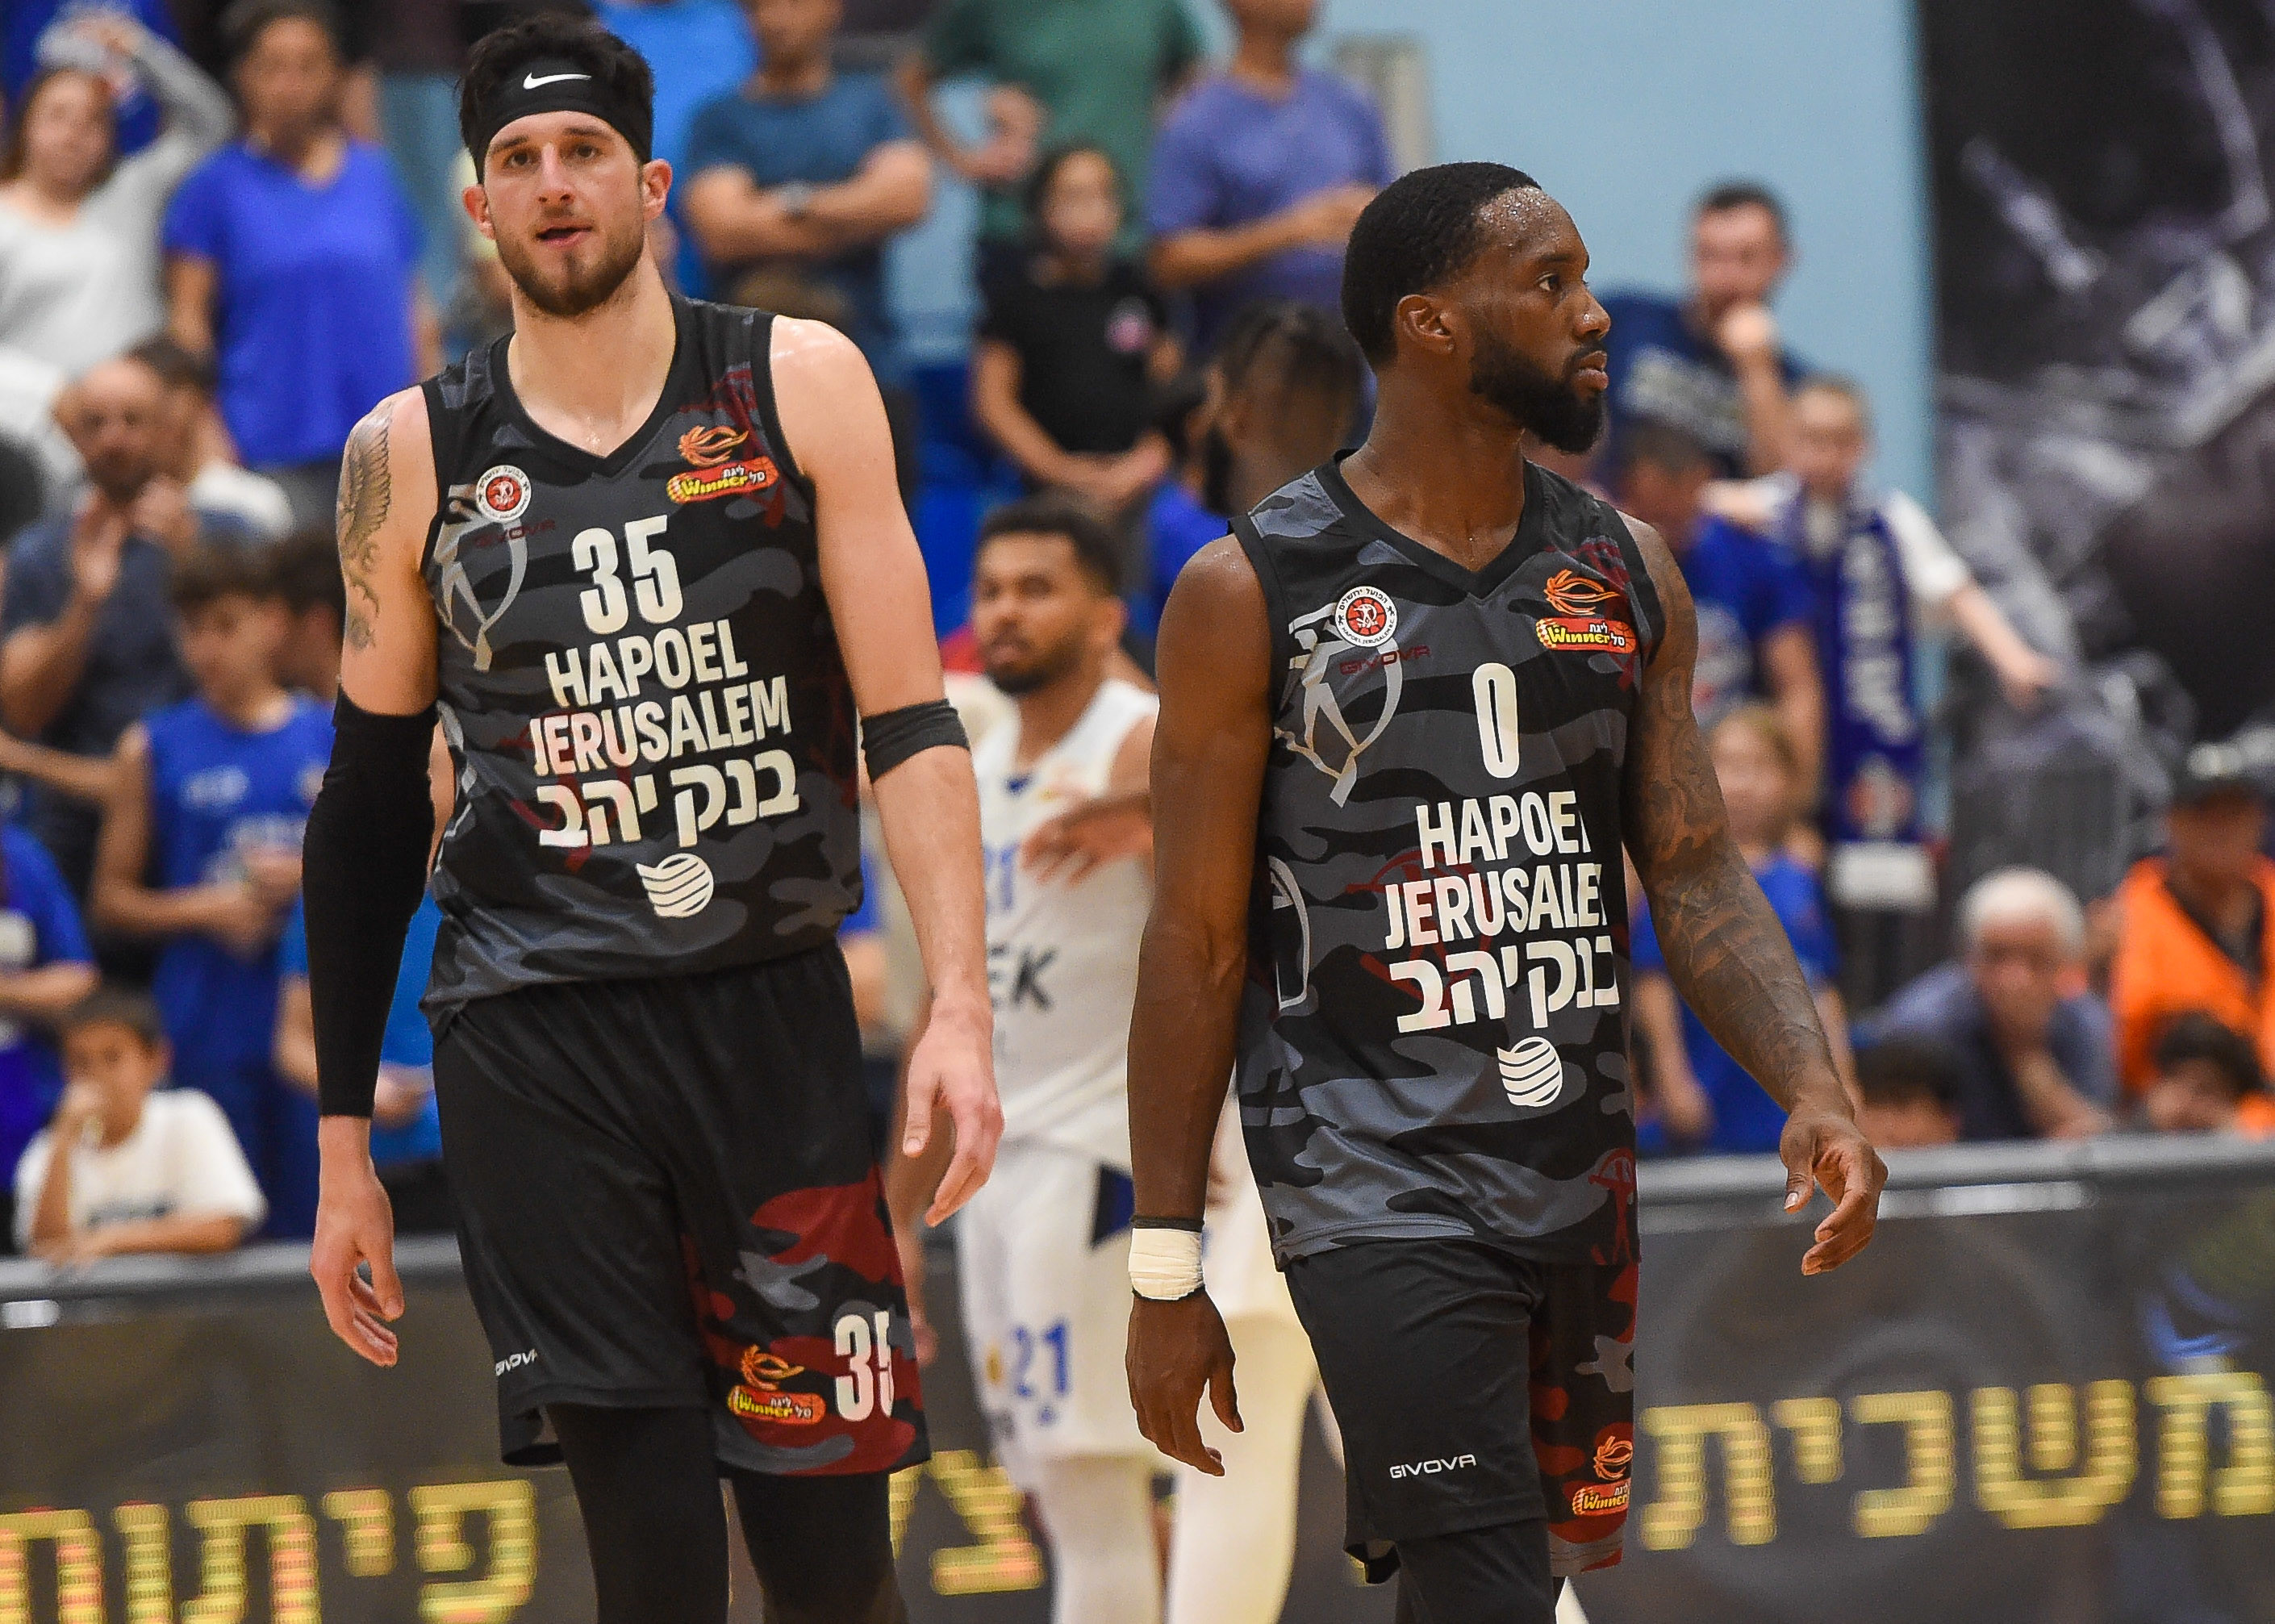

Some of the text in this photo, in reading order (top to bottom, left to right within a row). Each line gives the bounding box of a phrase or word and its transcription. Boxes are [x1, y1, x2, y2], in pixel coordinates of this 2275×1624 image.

[573, 515, 683, 636] 35
[545, 619, 749, 708] HAPOEL
[1339, 645, 1431, 675] GIVOVA
[1589, 623, 1608, 633] ליגת
[1610, 632, 1626, 646] סל
[528, 675, 792, 777] JERUSALEM
[1471, 662, 1521, 779] 0
[535, 749, 801, 849] בנק יהב
[1389, 946, 1518, 1033] יהב
[1012, 1318, 1071, 1400] 21
[1389, 1454, 1477, 1479] GIVOVA
